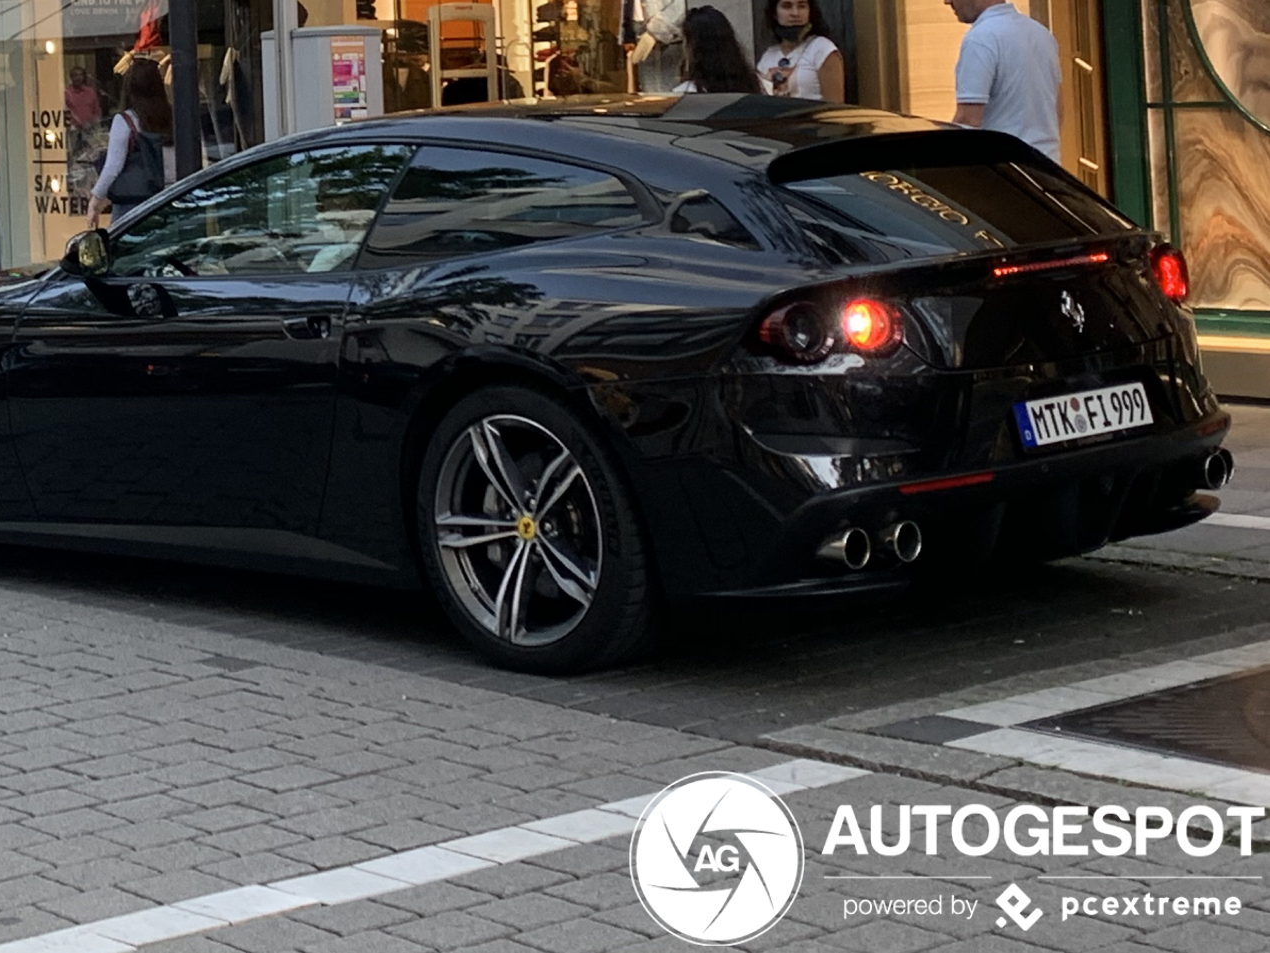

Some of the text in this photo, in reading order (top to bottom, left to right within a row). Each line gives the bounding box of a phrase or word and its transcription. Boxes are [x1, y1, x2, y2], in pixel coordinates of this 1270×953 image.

[32, 110, 71, 128] LOVE
[35, 195, 89, 215] WATER
[1030, 387, 1146, 441] MTK FI 999
